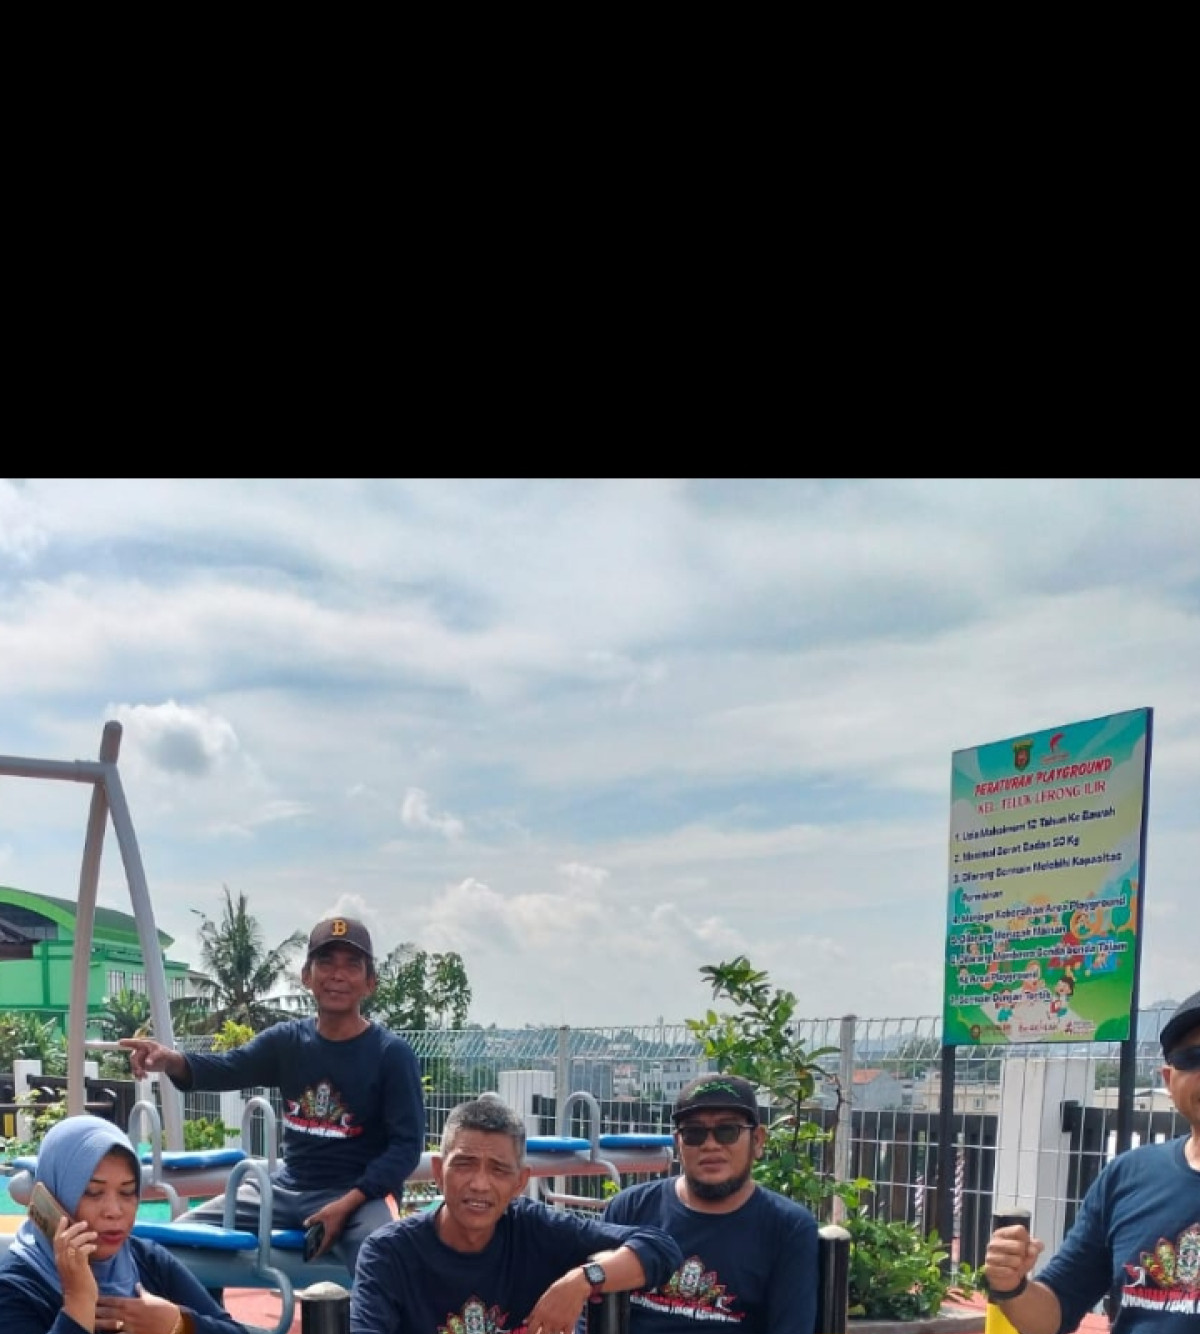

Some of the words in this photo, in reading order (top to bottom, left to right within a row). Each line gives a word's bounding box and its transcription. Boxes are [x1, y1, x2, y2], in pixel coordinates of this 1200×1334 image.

[975, 774, 1032, 796] PERATURAN
[1037, 758, 1112, 784] PLAYGROUND
[1002, 796, 1031, 810] TELUK
[1036, 785, 1081, 802] LERONG
[1084, 780, 1106, 795] ILIR
[1039, 815, 1067, 829] Tahun
[1082, 806, 1116, 821] Bawah
[1023, 839, 1051, 853] Badan
[1067, 834, 1080, 846] Kg
[962, 870, 994, 882] Dilarang
[1073, 852, 1122, 867] Kapasitas
[1069, 897, 1126, 912] Playground
[331, 919, 347, 936] B
[991, 970, 1039, 984] Playground
